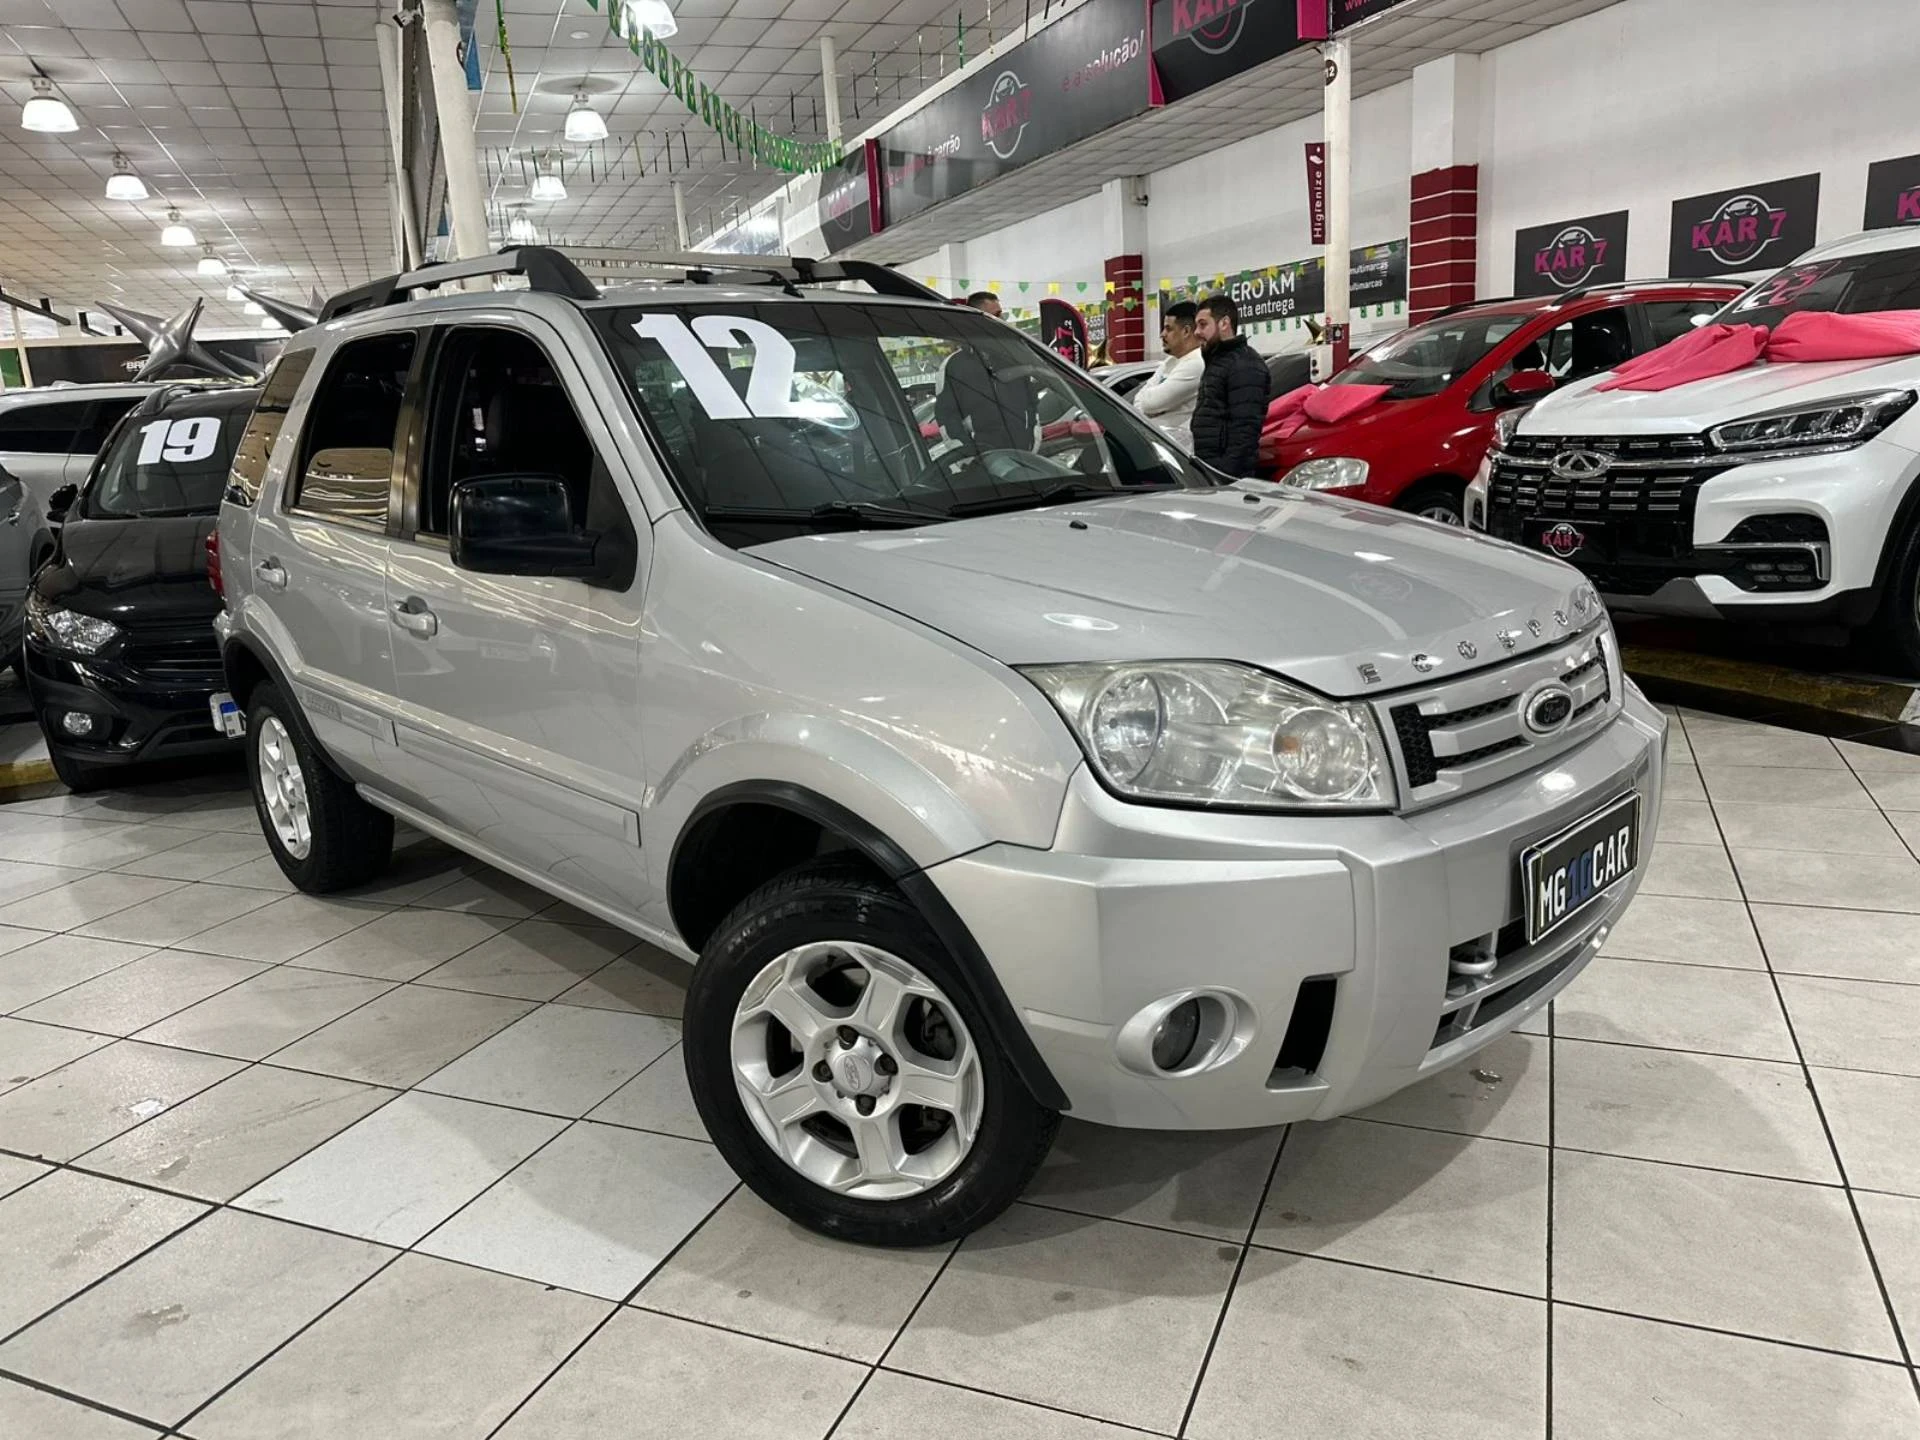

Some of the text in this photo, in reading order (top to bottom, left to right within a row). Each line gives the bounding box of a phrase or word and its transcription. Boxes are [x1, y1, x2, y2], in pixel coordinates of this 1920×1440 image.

[1313, 171, 1325, 239] Higienize
[1691, 211, 1787, 249] KAR 7
[1535, 241, 1607, 273] KAR 7
[1223, 270, 1295, 303] ERO KM
[1254, 298, 1296, 316] entrega
[631, 313, 848, 419] 12
[137, 417, 221, 465] 19
[1542, 532, 1572, 547] KAR
[1540, 825, 1629, 929] MG10CAR
